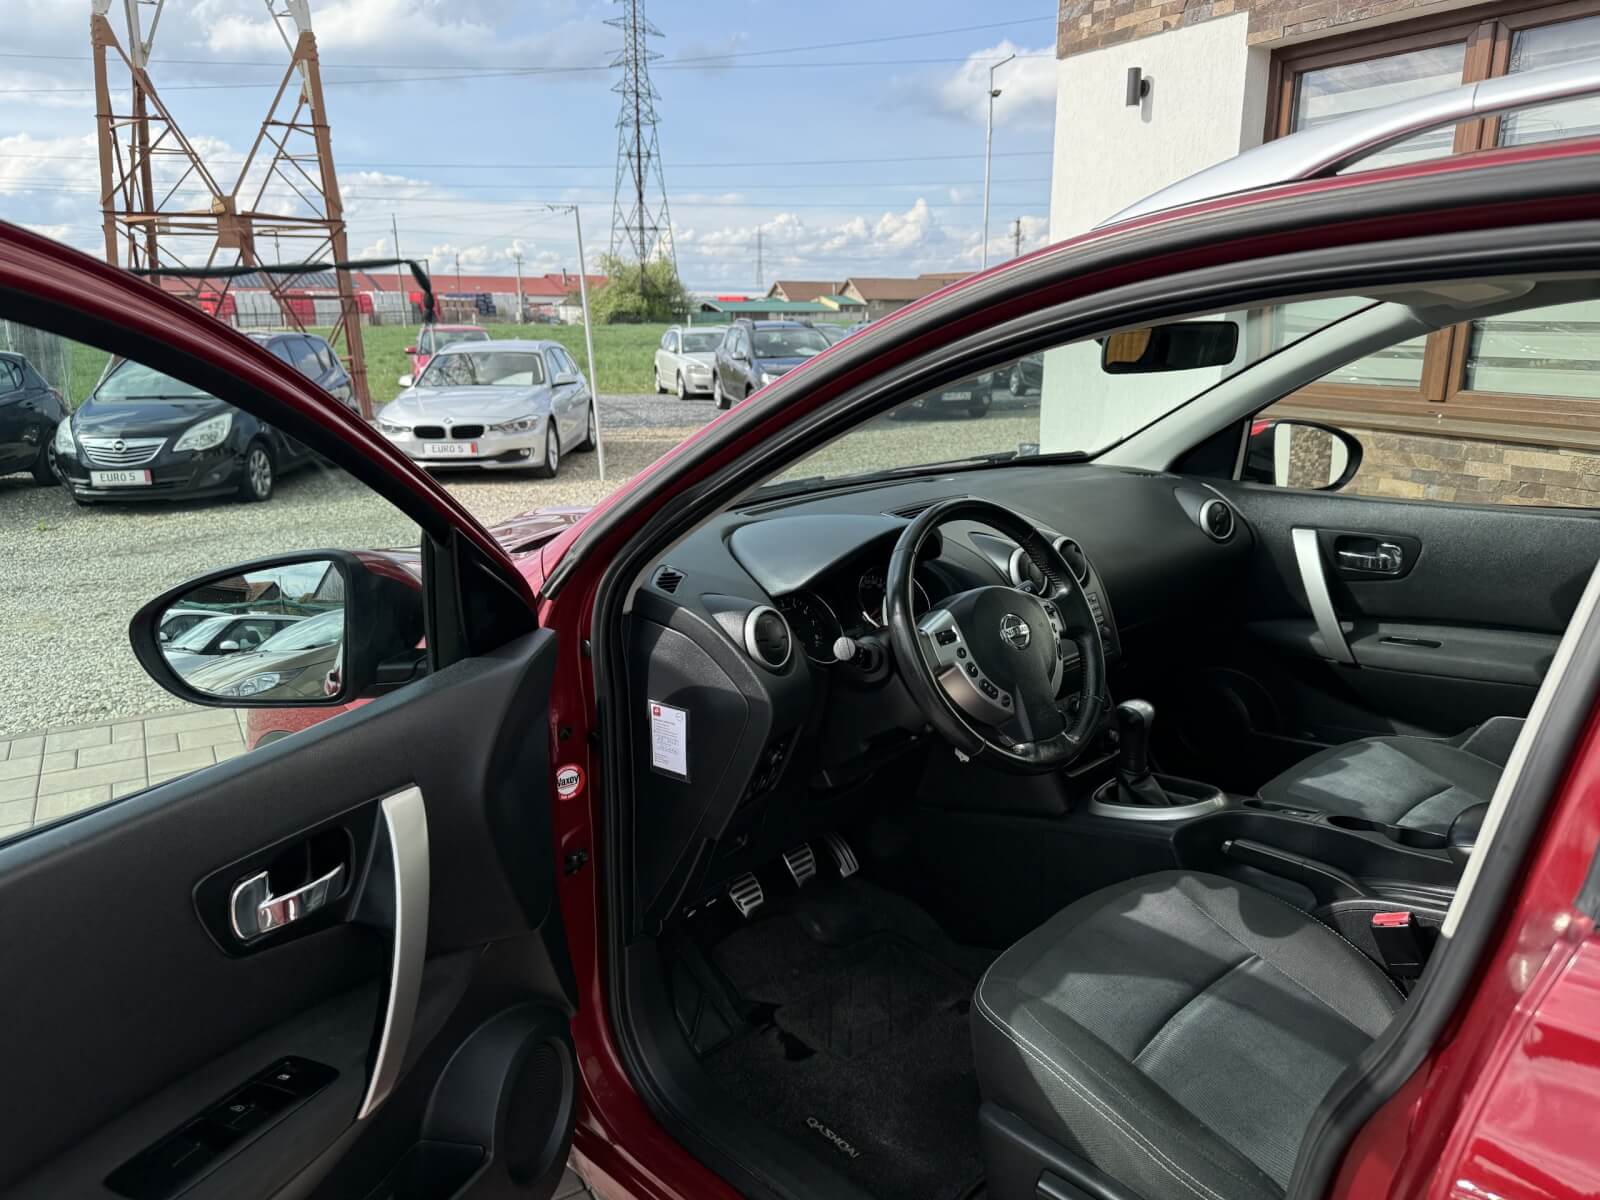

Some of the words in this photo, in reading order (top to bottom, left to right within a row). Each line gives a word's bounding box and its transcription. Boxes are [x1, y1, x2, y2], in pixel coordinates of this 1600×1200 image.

[432, 444, 455, 453] EURO
[457, 444, 464, 453] 5
[100, 472, 127, 482] EURO
[128, 472, 136, 481] 5
